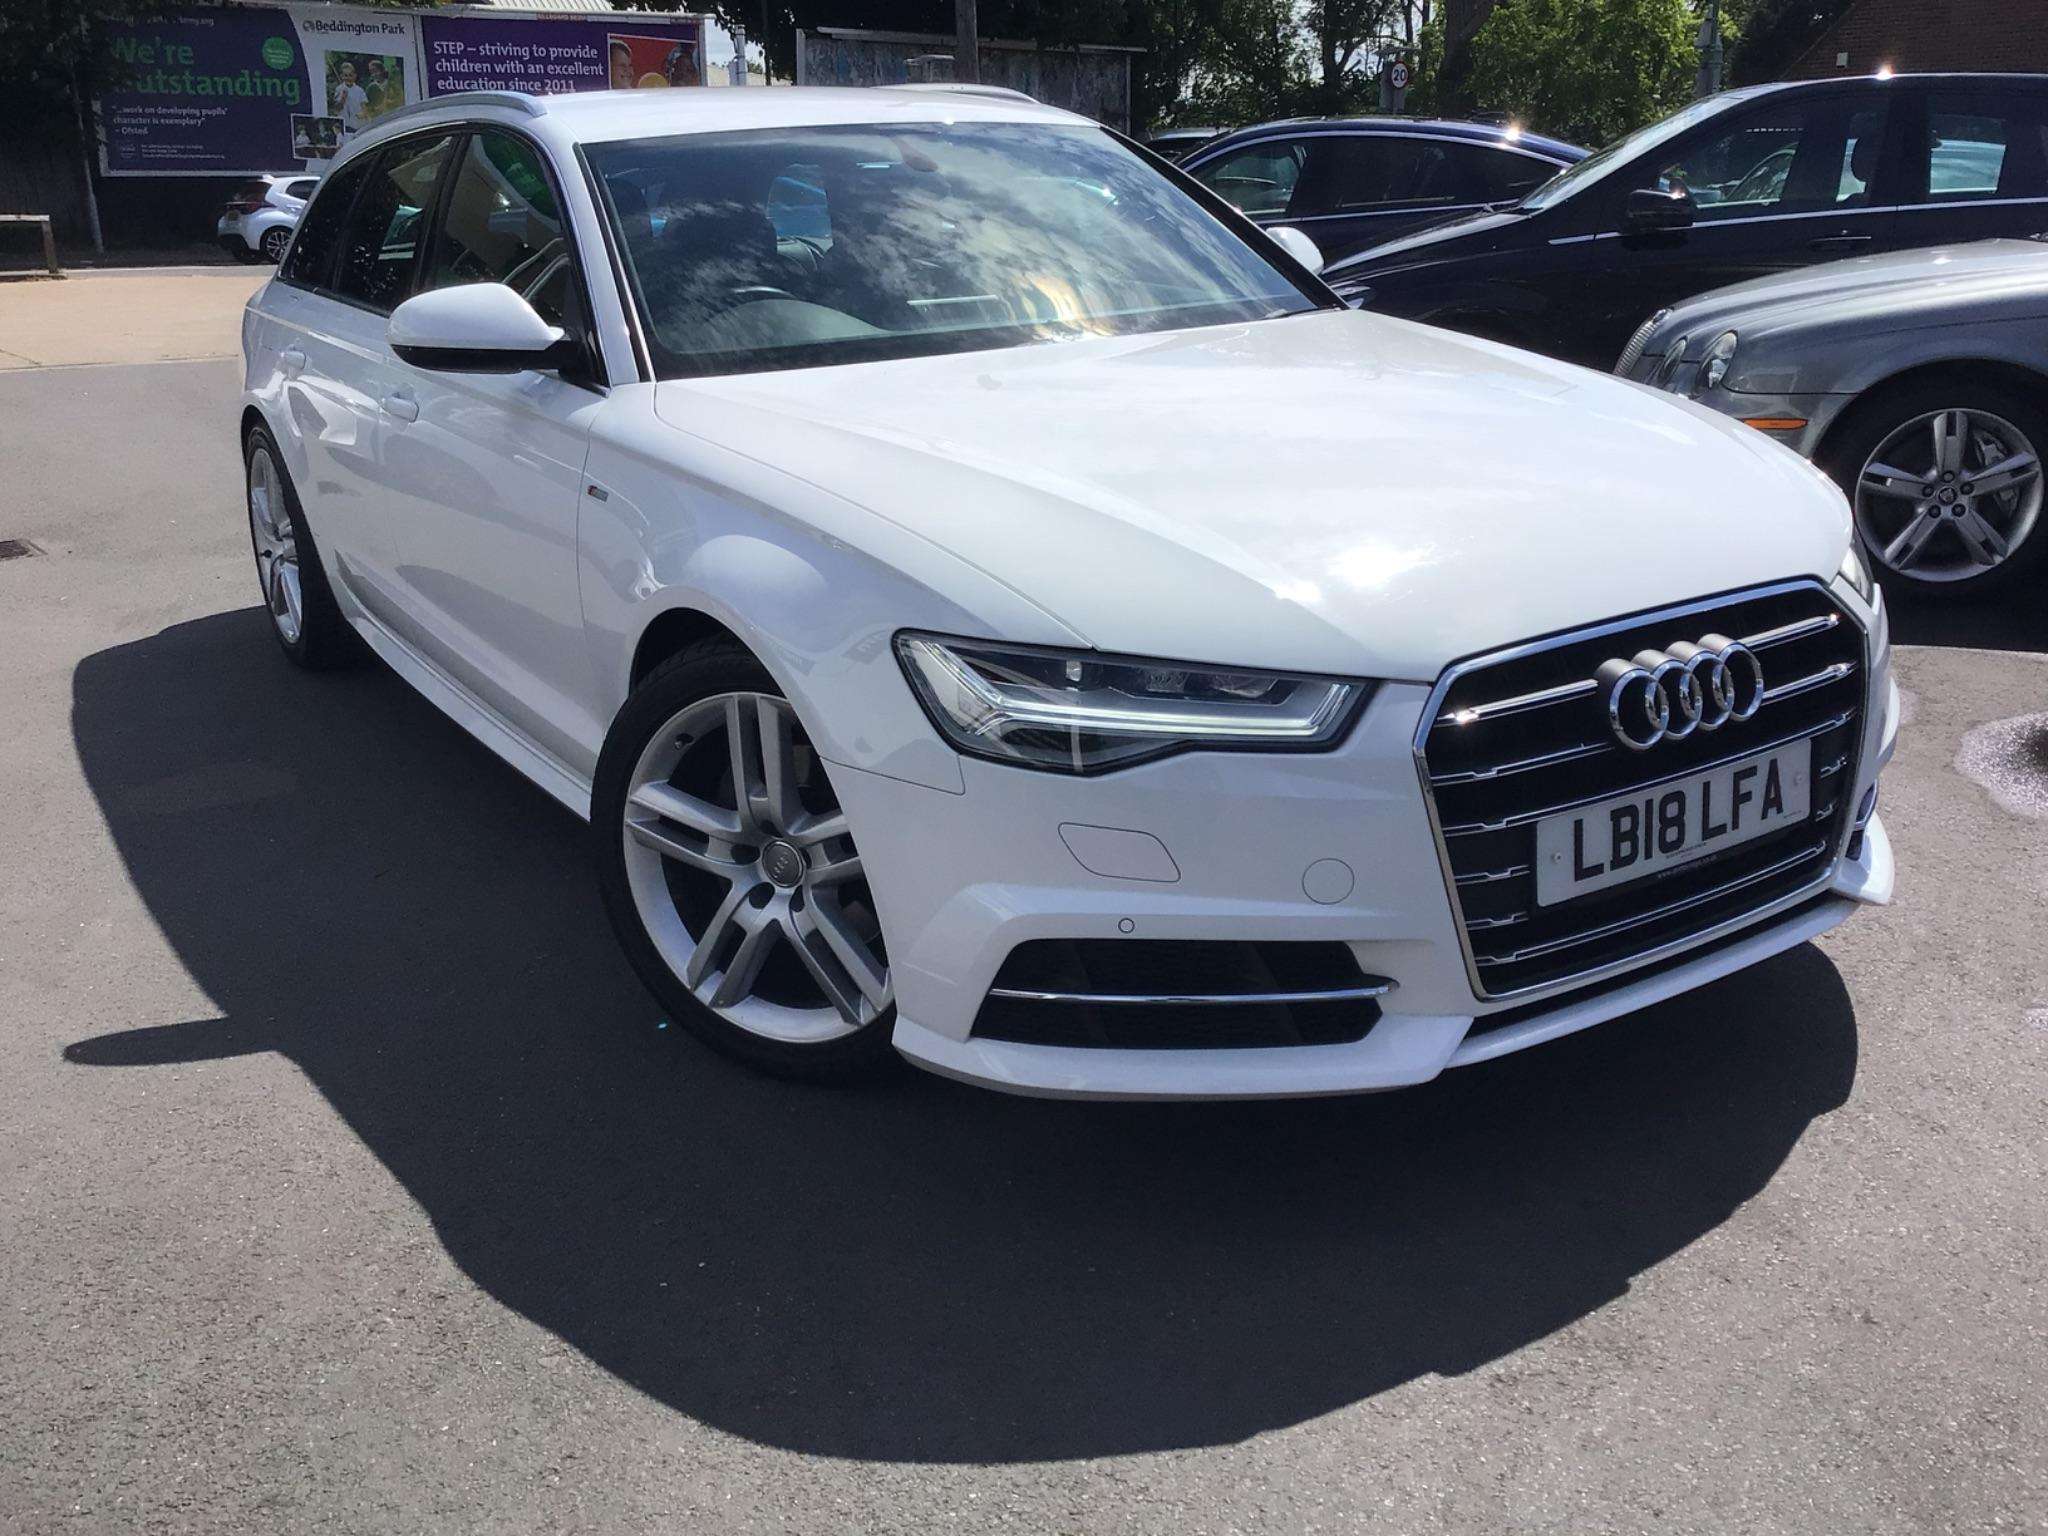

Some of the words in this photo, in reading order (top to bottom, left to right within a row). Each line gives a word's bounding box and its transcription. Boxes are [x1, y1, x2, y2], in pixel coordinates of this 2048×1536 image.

[315, 20, 380, 35] Beddington
[381, 23, 405, 34] Park
[433, 41, 464, 54] STEP
[479, 42, 529, 60] striving
[532, 44, 547, 57] to
[549, 45, 598, 60] provide
[435, 59, 491, 73] children
[494, 60, 524, 74] with
[527, 64, 544, 74] an
[547, 61, 604, 75] excellent
[1393, 69, 1406, 82] 20
[136, 69, 300, 105] utstanding
[437, 76, 506, 90] education
[508, 77, 542, 91] since
[544, 79, 576, 92] 2011
[156, 106, 201, 117] developing
[113, 117, 150, 125] character
[121, 127, 149, 135] Ofsted
[1574, 790, 1686, 882] LB18
[1702, 758, 1784, 842] LFA
